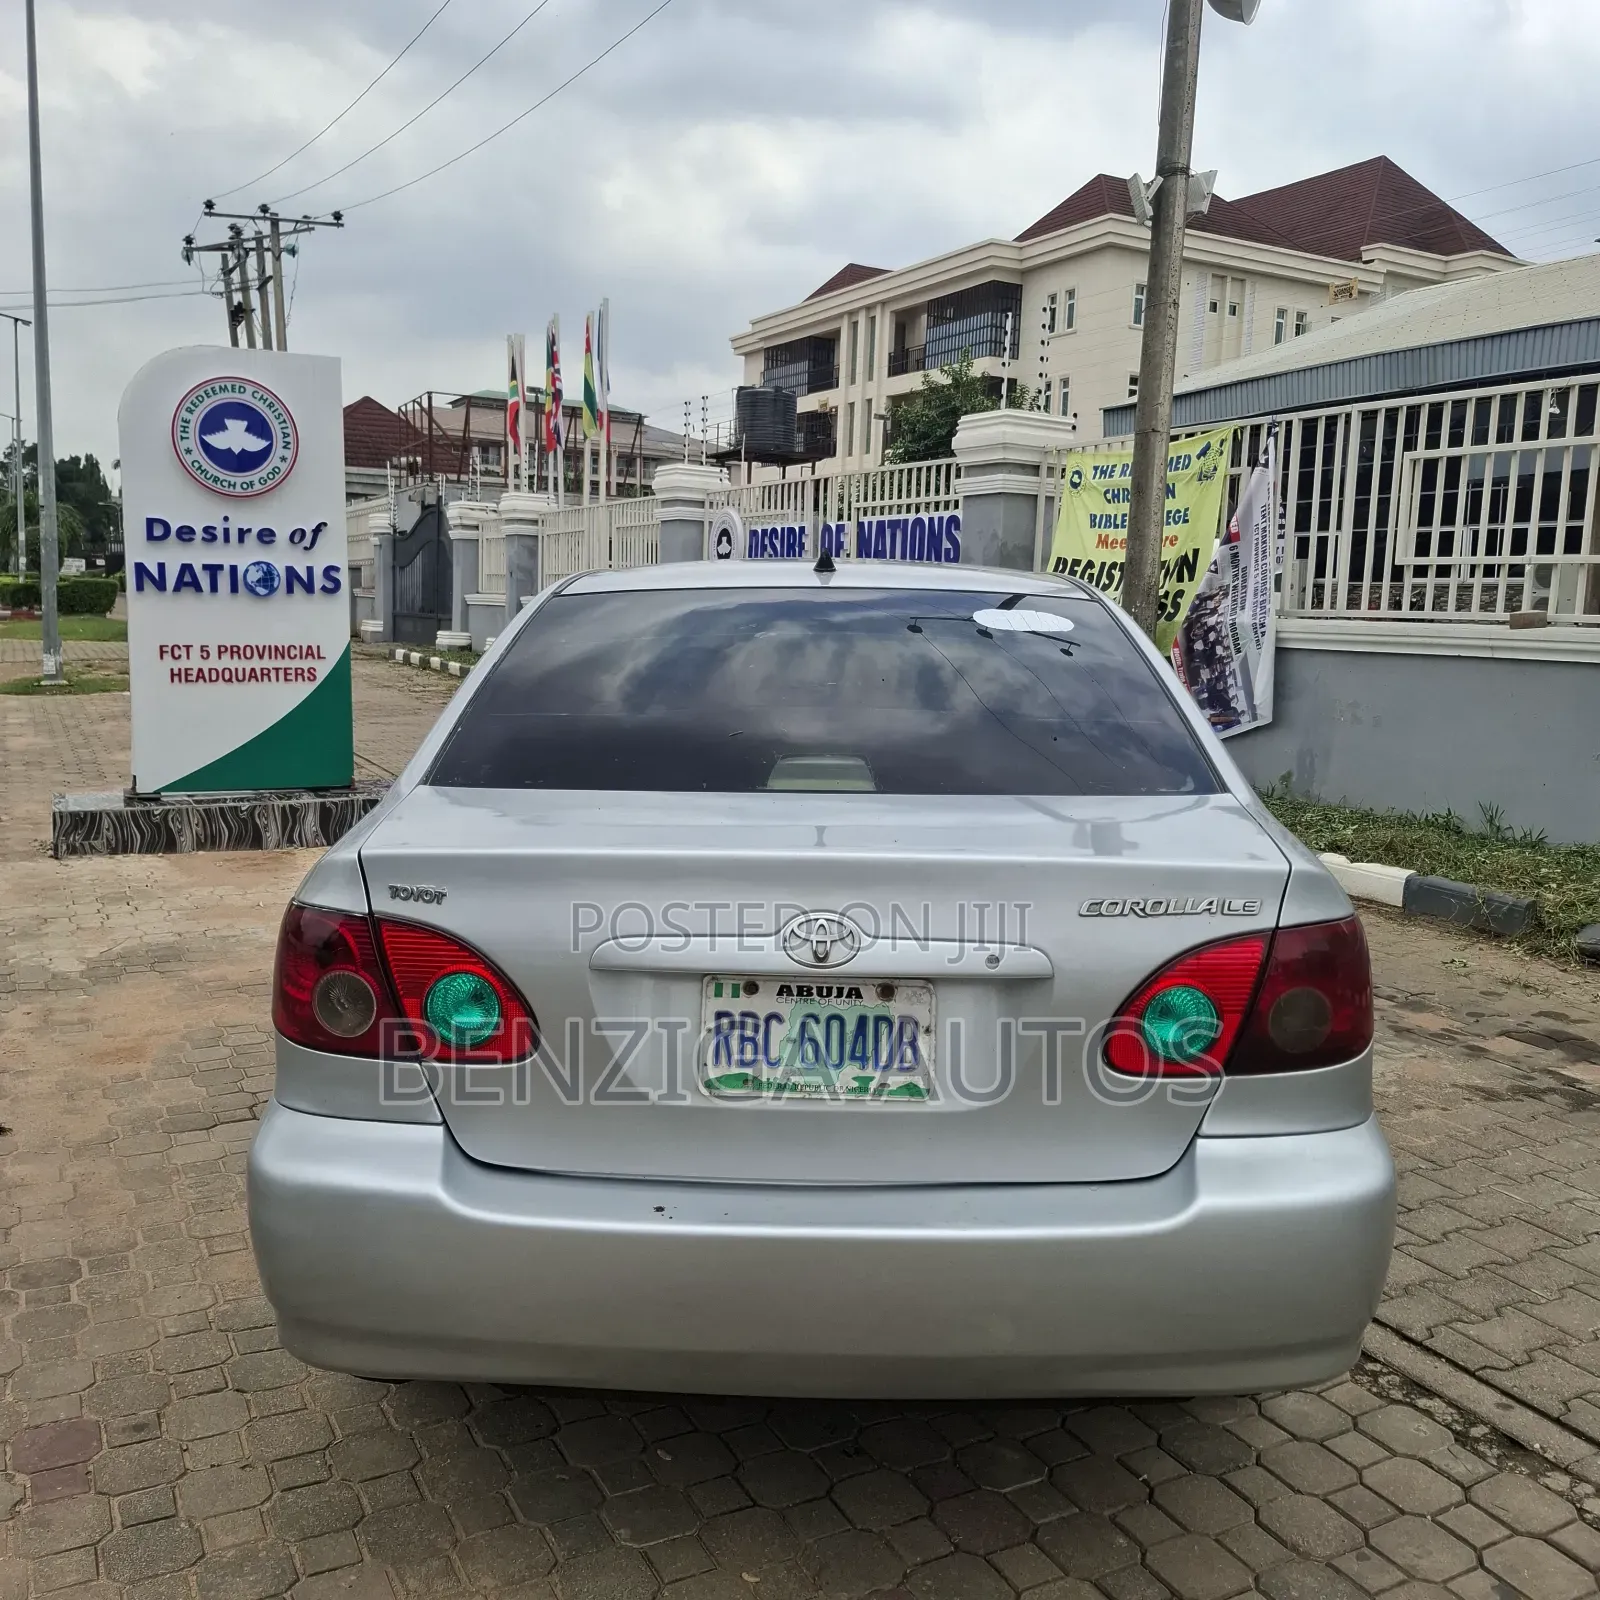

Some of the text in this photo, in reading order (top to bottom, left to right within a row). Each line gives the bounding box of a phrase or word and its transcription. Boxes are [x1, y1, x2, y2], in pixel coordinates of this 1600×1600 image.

[180, 383, 291, 451] THE REDEEMED CHRISTIAN
[191, 459, 281, 491] CHURCH OF GOD
[1092, 463, 1118, 480] THE
[145, 515, 328, 551] Desire of
[1089, 513, 1128, 529] BIBLE
[748, 525, 806, 558] DESIRE
[820, 523, 846, 558] OF
[858, 514, 962, 563] NATIONS
[1095, 533, 1127, 550] Mee
[1260, 525, 1268, 561] MAKING
[134, 560, 342, 598] NATIONS
[1230, 552, 1240, 584] MONTHS
[1260, 562, 1268, 599] COURSE
[1229, 583, 1240, 617] WEEKEND
[1239, 565, 1248, 612] DURATION
[1258, 599, 1267, 630] BATCH
[159, 644, 327, 660] FCT 5 PROVINCIAL
[1228, 617, 1242, 656] PROGRAM
[170, 667, 317, 684] HEADQUARTERS
[388, 884, 448, 905] TOYOT
[1079, 897, 1262, 918] COROLLA LE
[776, 984, 864, 999] ABUJA
[776, 996, 816, 1004] CENTRE
[713, 1010, 920, 1073] RBC 604DB
